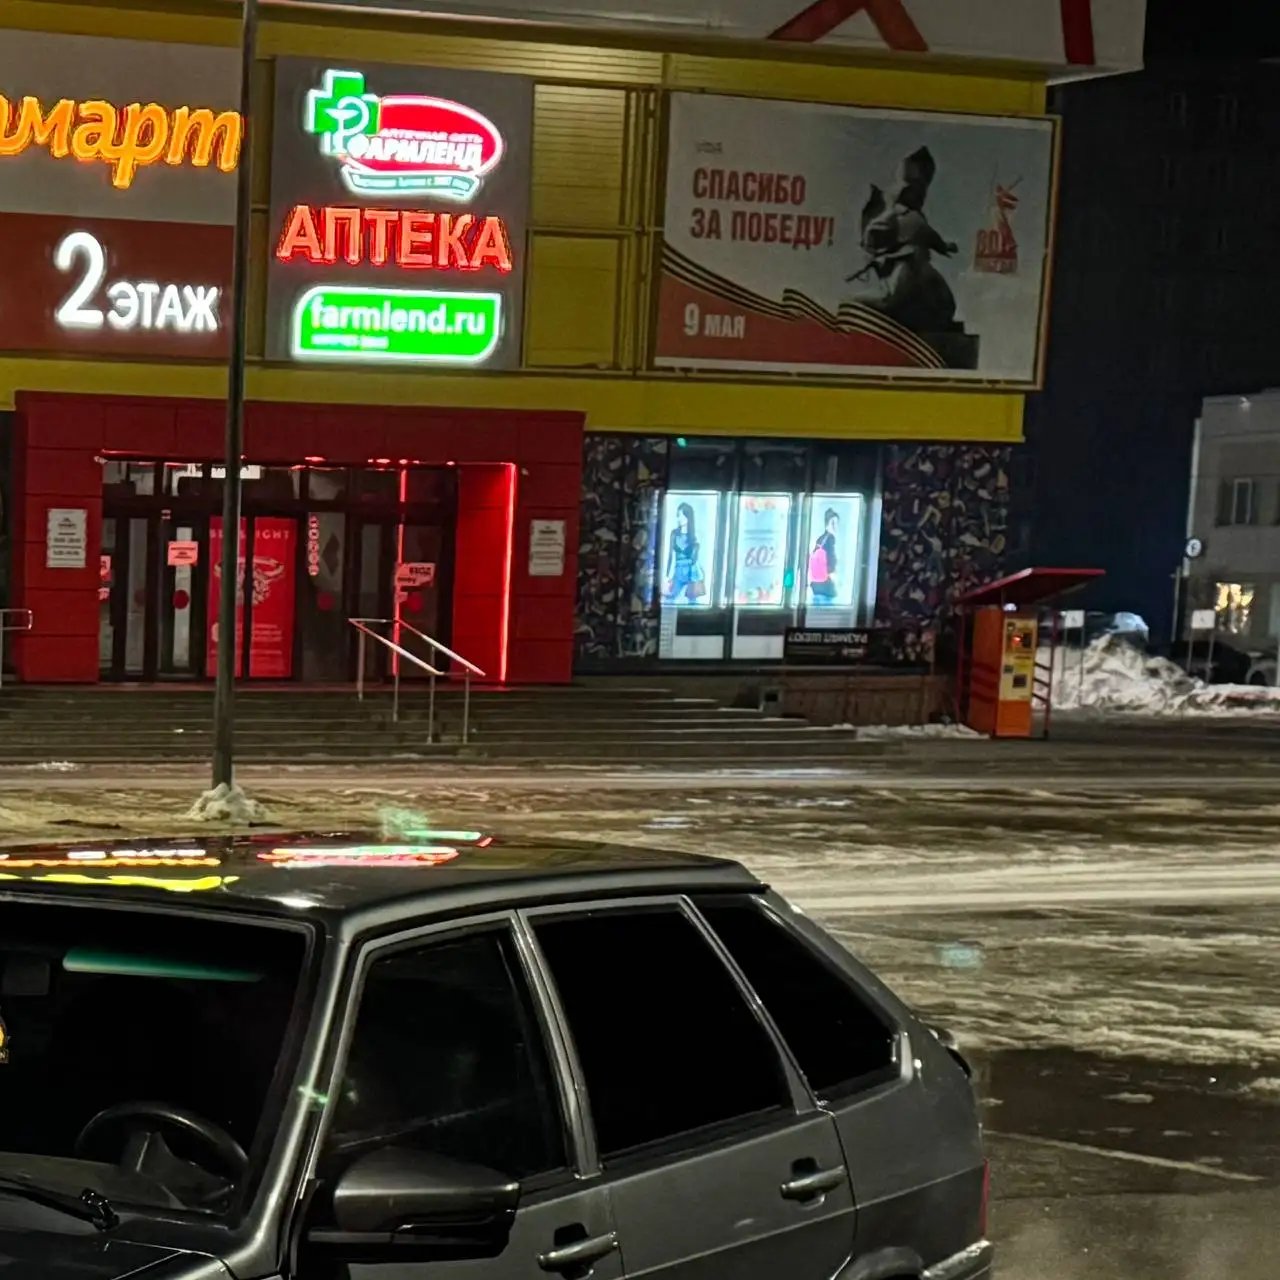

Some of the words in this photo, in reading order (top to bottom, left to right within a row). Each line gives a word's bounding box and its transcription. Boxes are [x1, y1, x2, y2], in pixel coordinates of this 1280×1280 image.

[693, 167, 806, 205] СПАСИБО
[276, 205, 513, 274] АПТЕКА
[690, 207, 722, 240] ЗА
[731, 210, 835, 250] ПОБЕДУ!
[55, 231, 106, 330] 2
[107, 281, 219, 332] ЭТАЖ
[310, 295, 486, 335] farmlend.ru
[684, 302, 700, 336] 9
[704, 314, 746, 339] МАЯ
